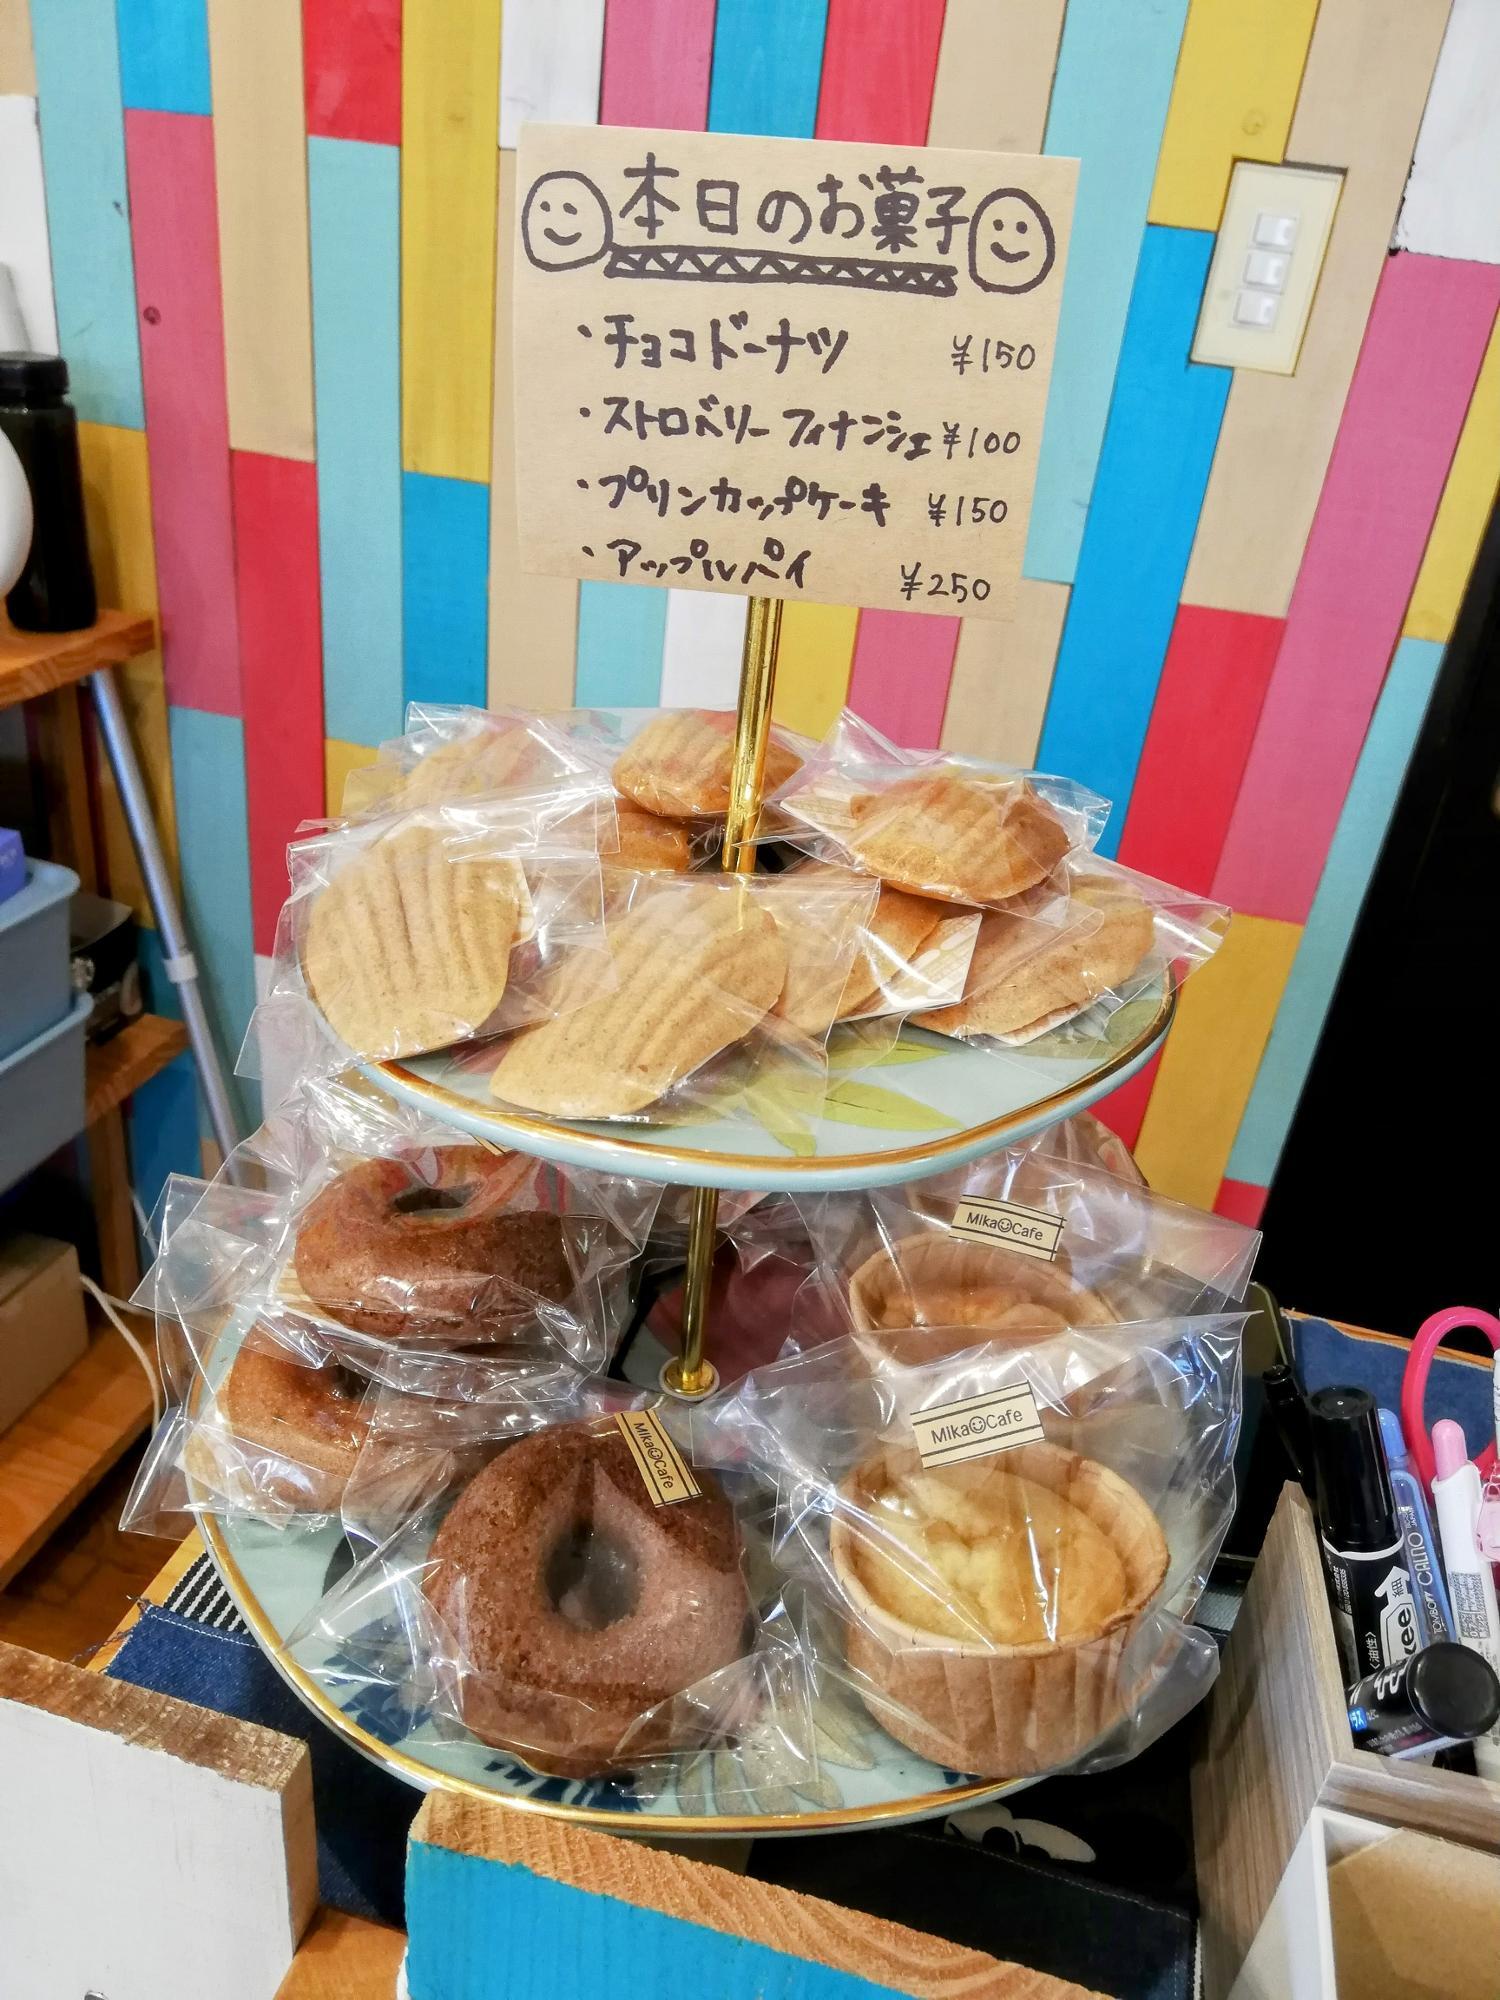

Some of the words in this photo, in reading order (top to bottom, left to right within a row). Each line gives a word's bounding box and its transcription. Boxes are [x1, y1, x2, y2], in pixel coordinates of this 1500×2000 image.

[619, 152, 970, 255] 本日のお菓子
[951, 334, 1036, 375] ¥150
[942, 421, 1021, 460] ¥100
[927, 492, 1008, 528] ¥150
[899, 561, 991, 604] ¥250
